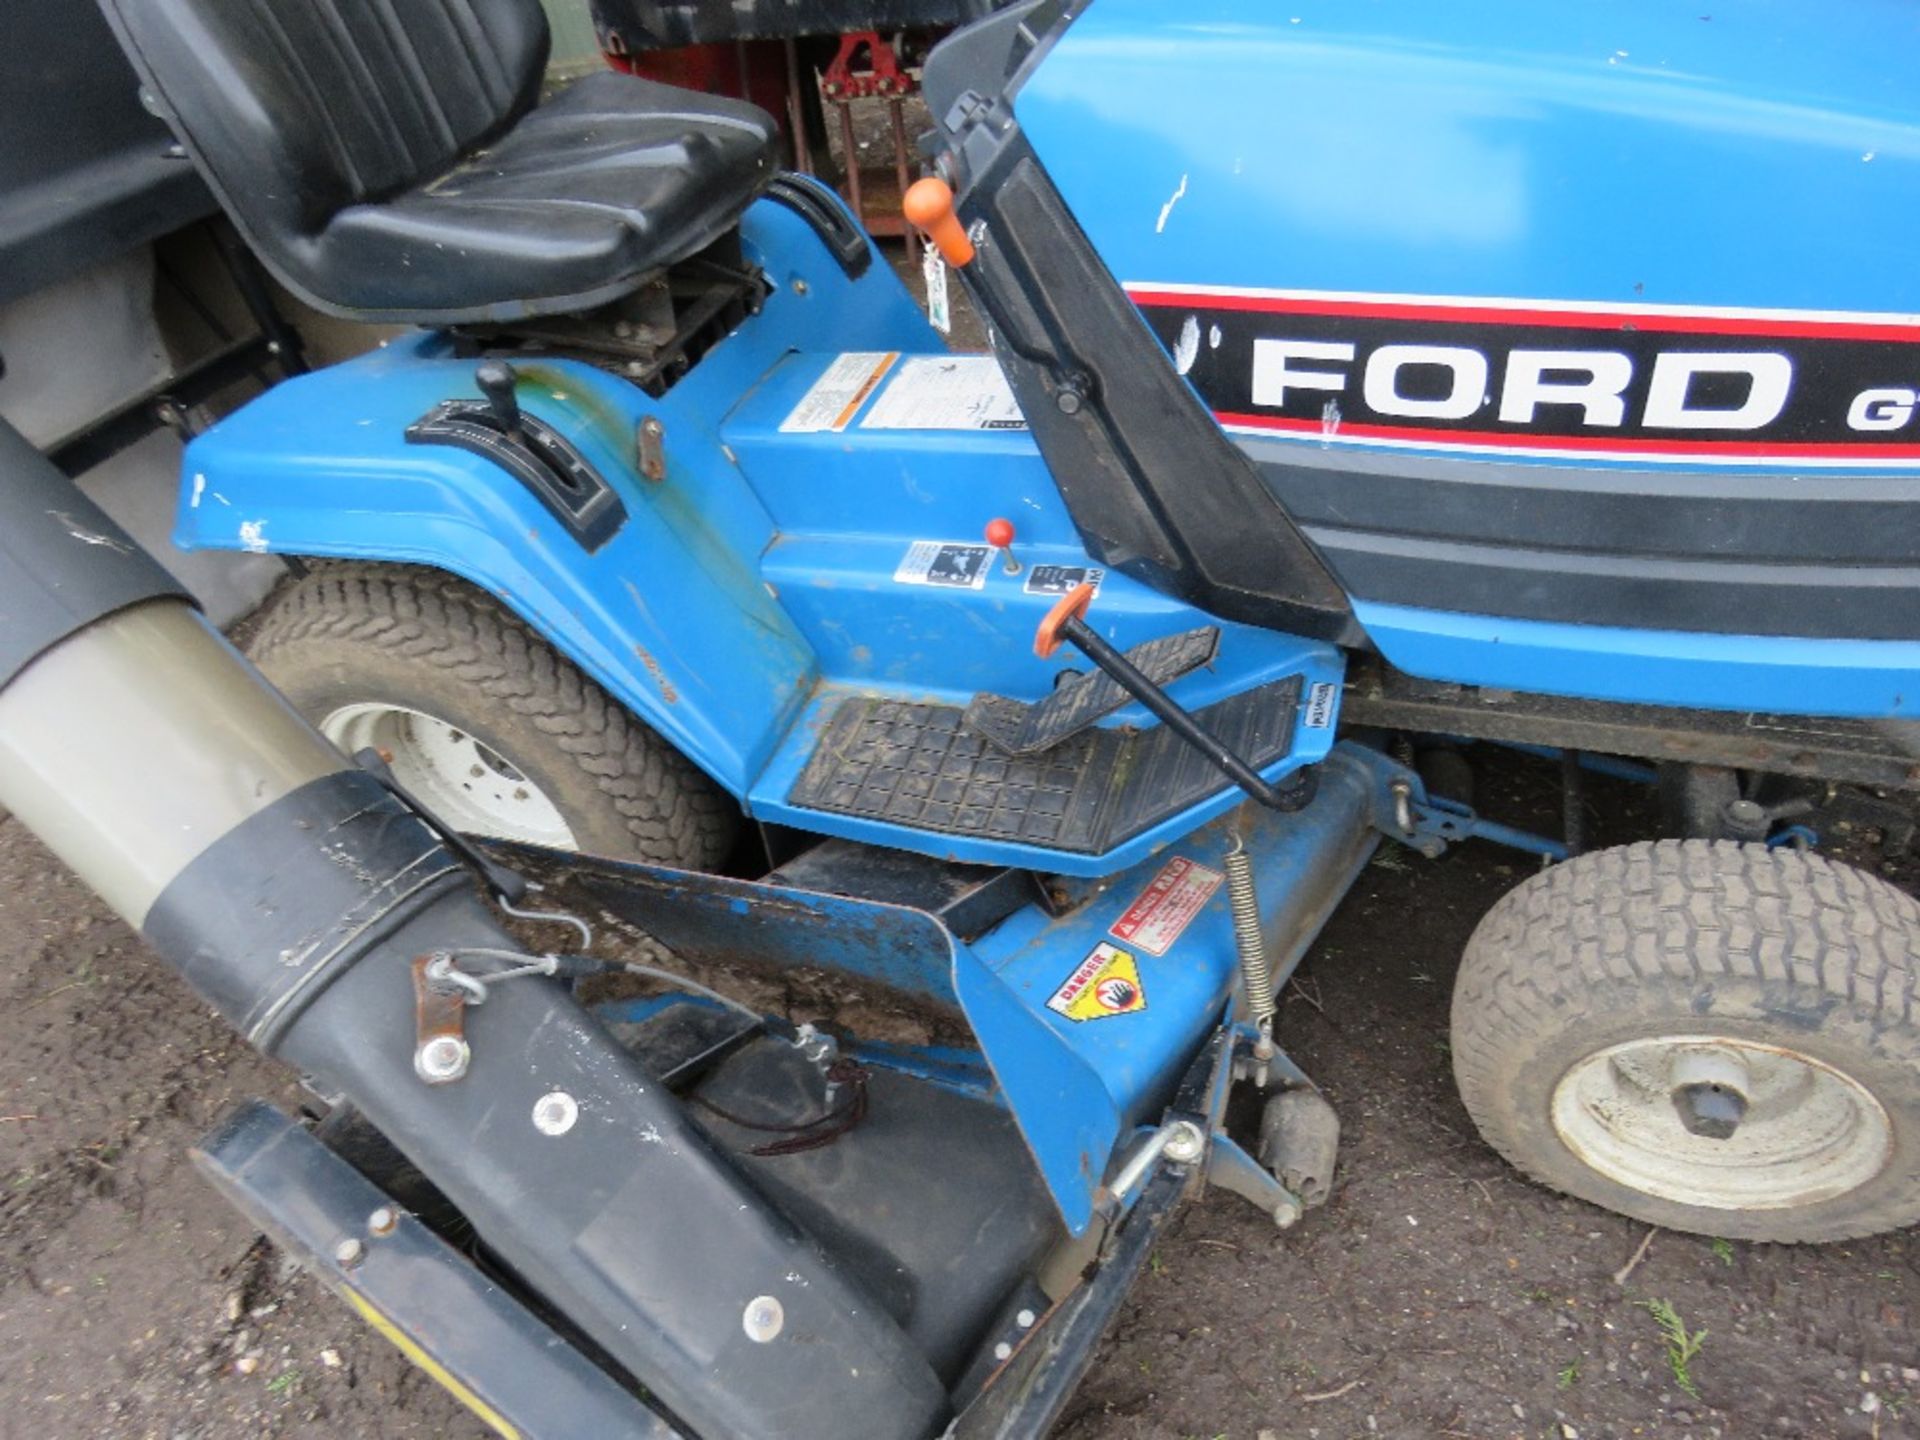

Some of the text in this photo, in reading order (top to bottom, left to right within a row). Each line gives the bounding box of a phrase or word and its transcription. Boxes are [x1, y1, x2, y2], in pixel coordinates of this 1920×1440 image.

[1251, 338, 1920, 431] FORD G
[1060, 953, 1106, 1001] DANGER
